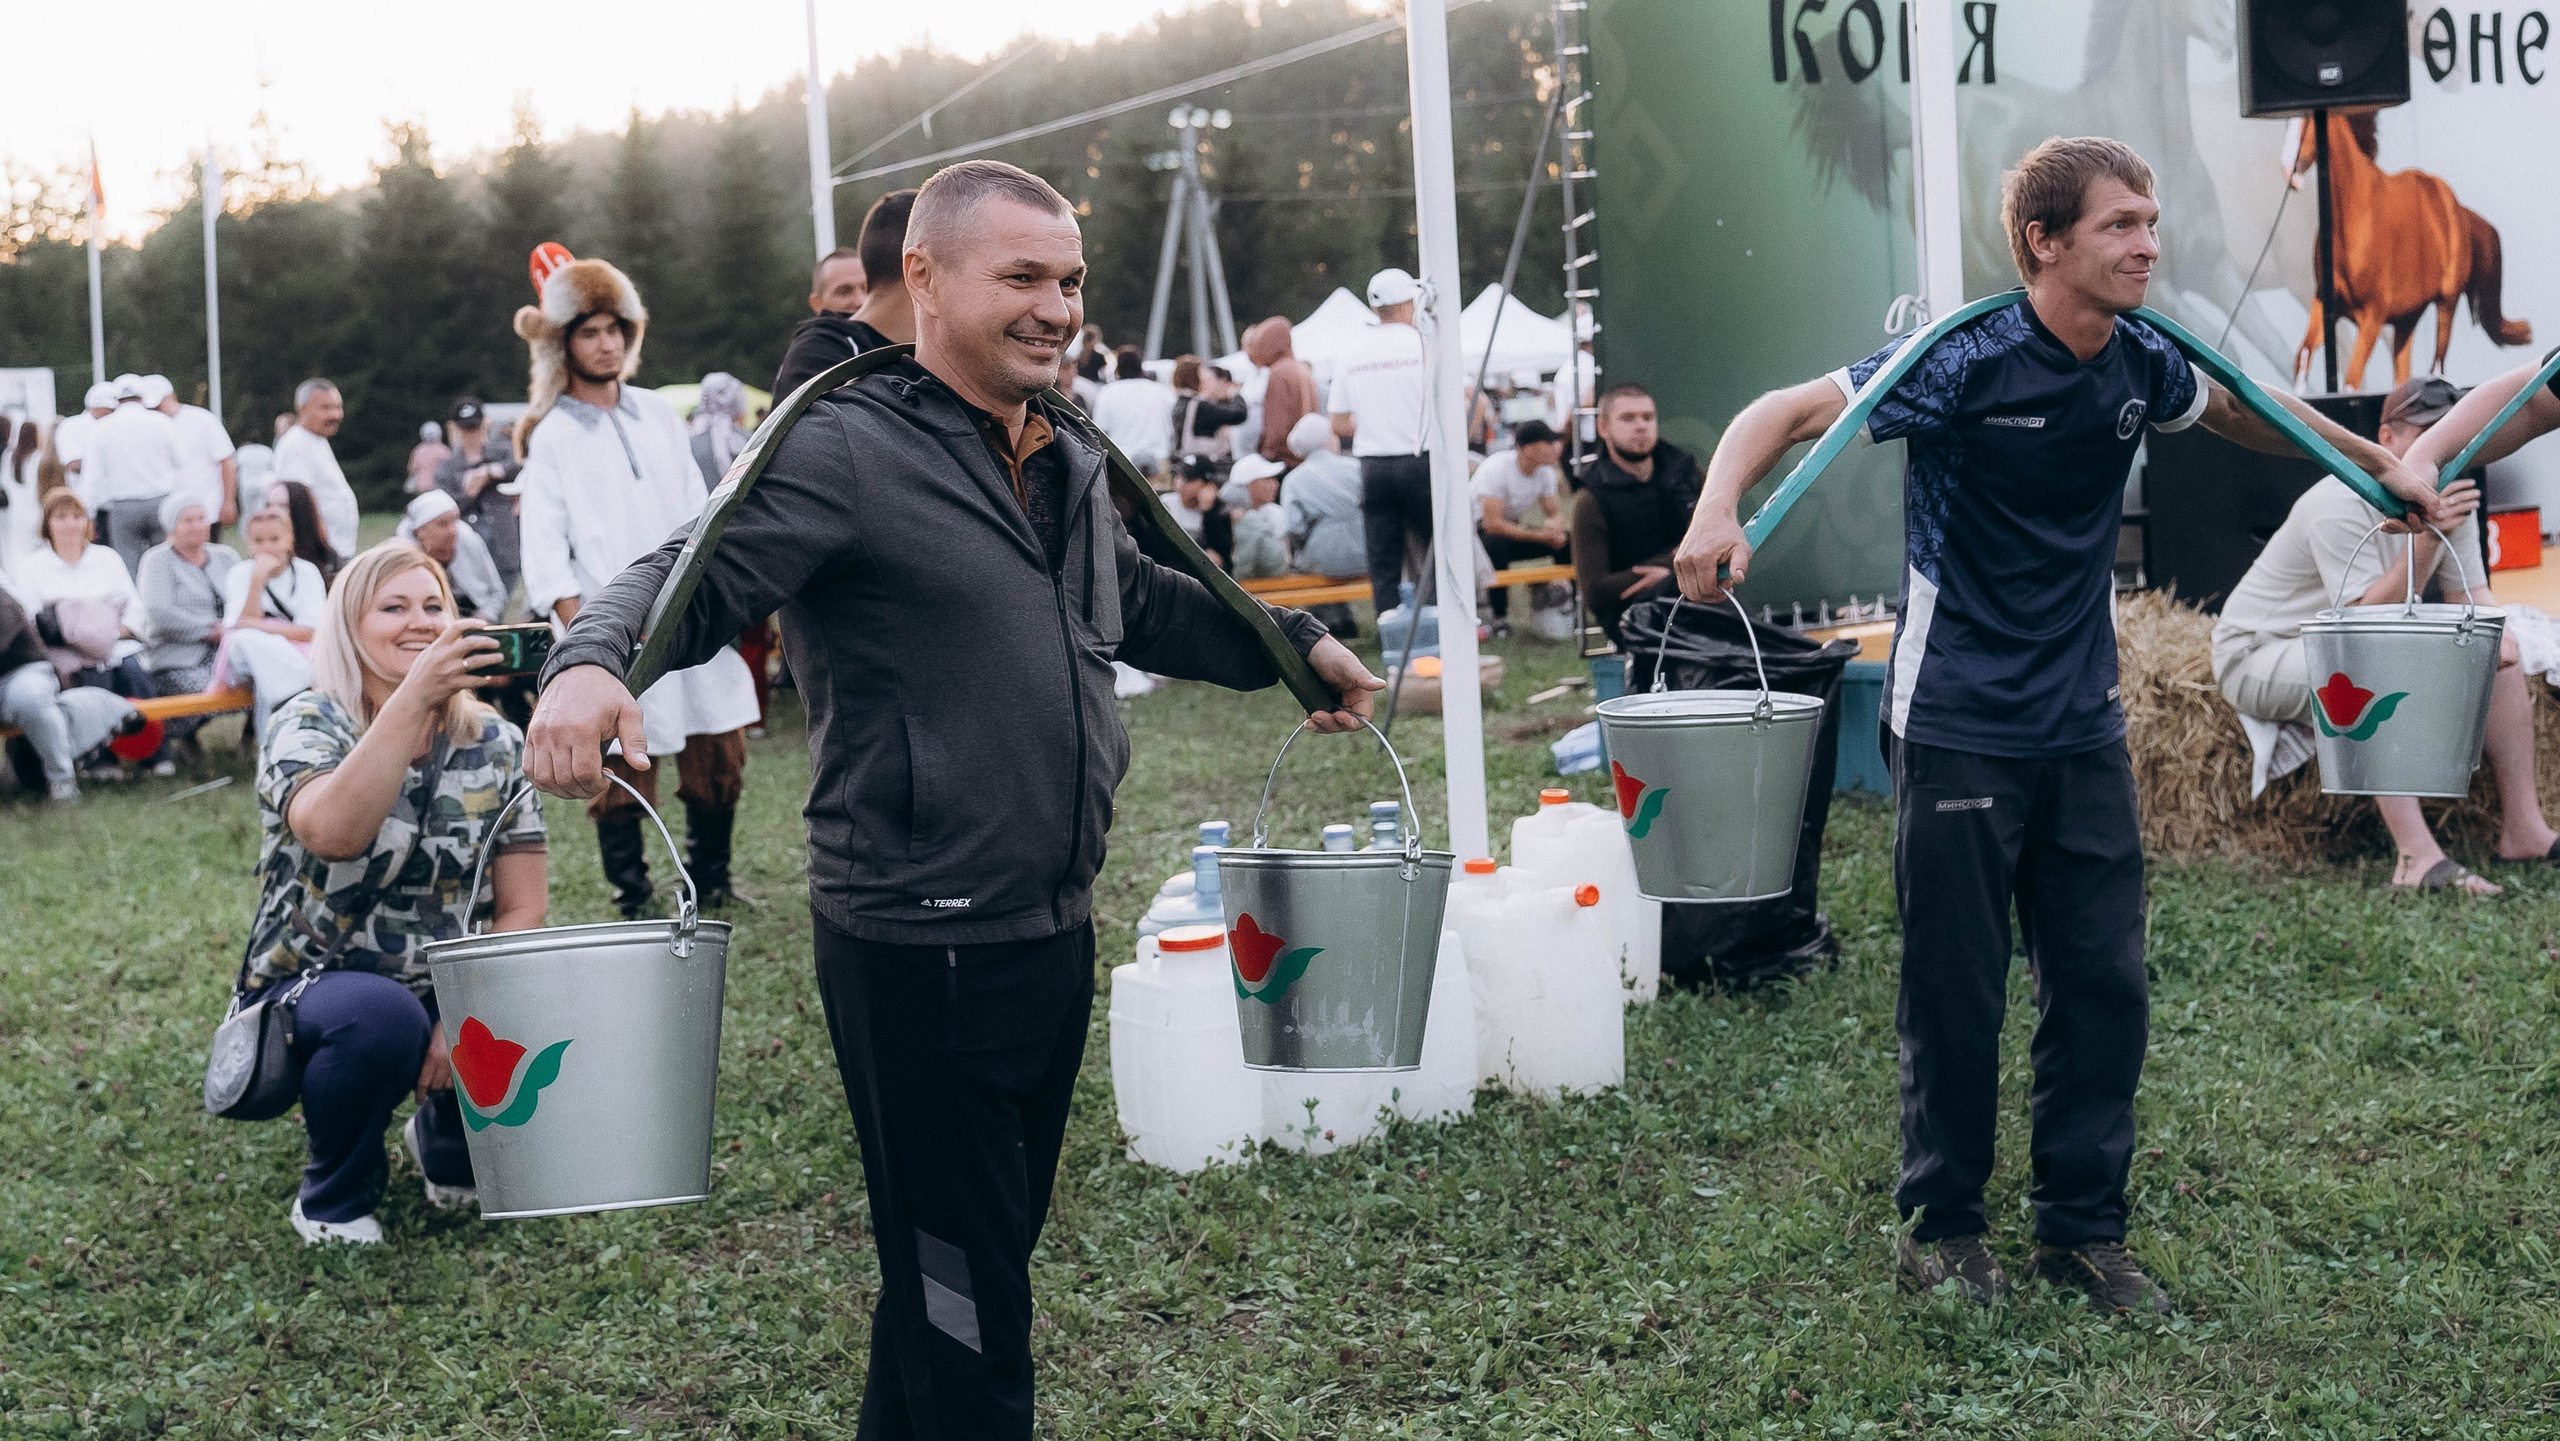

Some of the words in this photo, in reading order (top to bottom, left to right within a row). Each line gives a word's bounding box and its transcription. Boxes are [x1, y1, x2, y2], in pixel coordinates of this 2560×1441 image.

[1769, 0, 1997, 84] Коя
[2424, 7, 2549, 85] өне
[1983, 416, 2045, 428] МИНСПОРТ
[934, 898, 971, 907] TERREX
